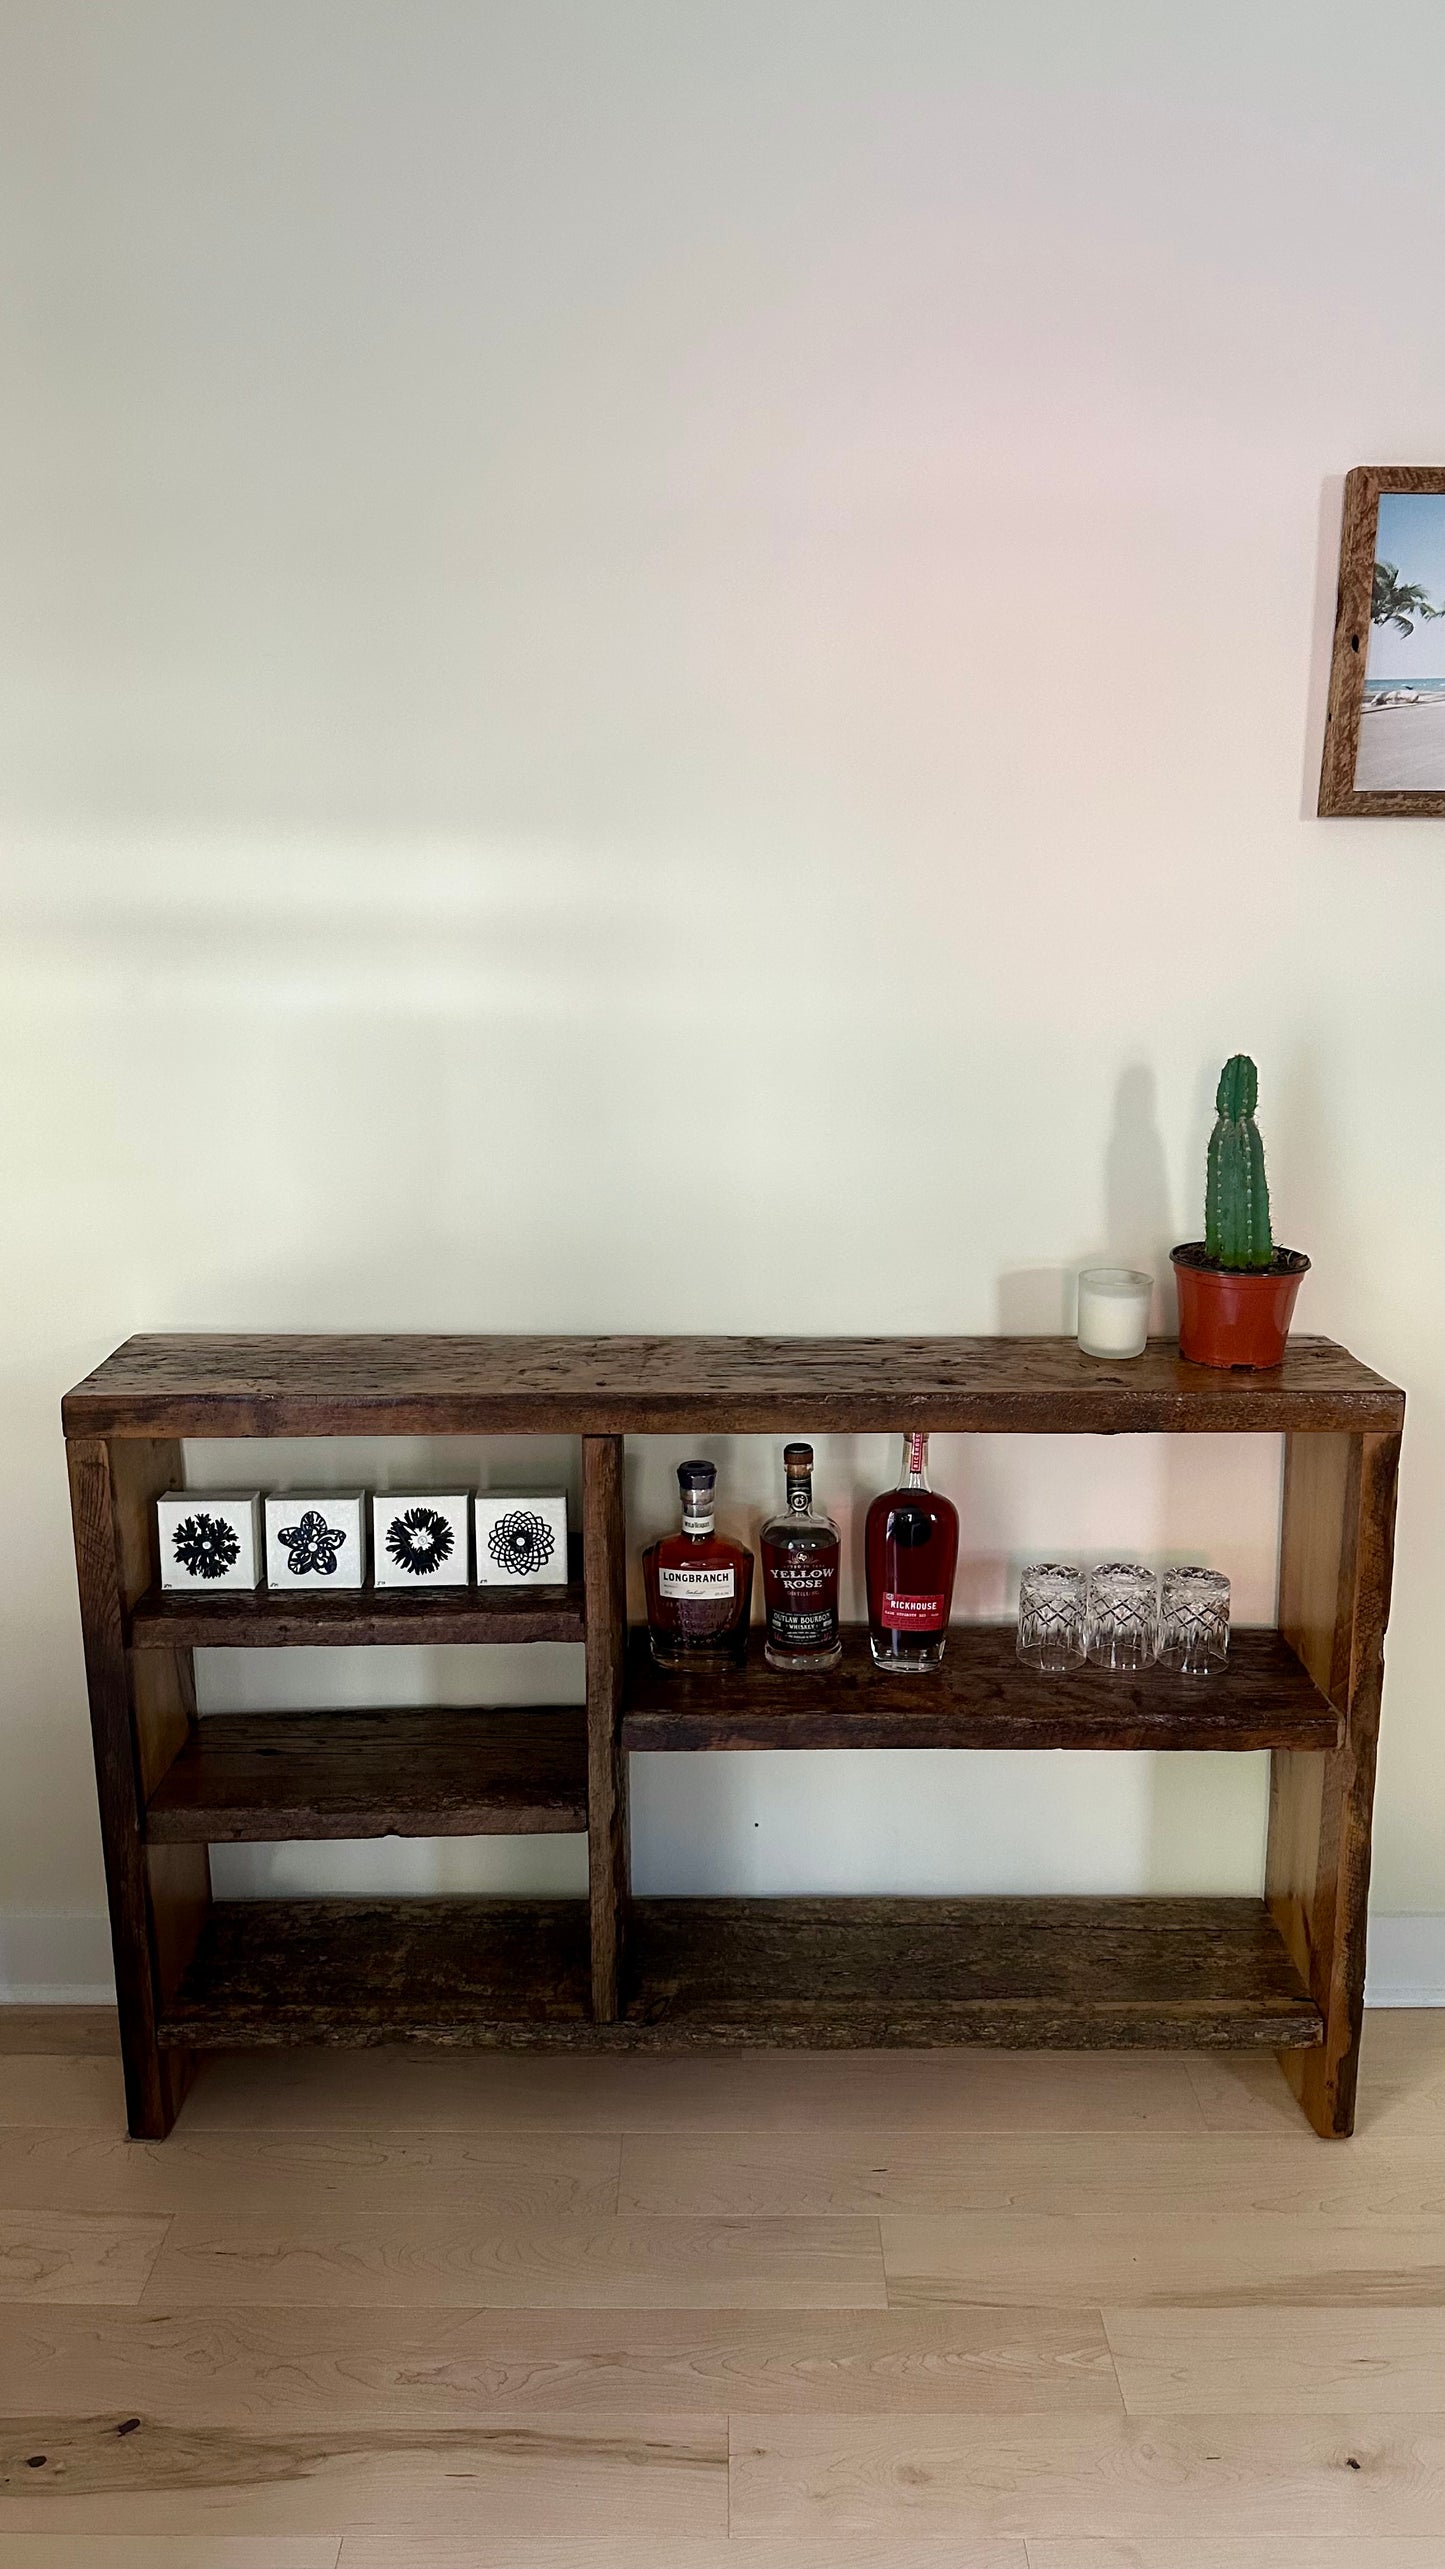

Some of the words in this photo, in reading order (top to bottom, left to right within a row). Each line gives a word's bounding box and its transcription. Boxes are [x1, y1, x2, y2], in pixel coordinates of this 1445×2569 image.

[663, 1572, 729, 1582] LONGBRANCH
[770, 1568, 834, 1578] YELLOW
[783, 1580, 823, 1589] ROSE
[890, 1600, 937, 1611] RICKHOUSE
[773, 1612, 798, 1624] OUTLAW
[800, 1612, 831, 1624] BOURBON
